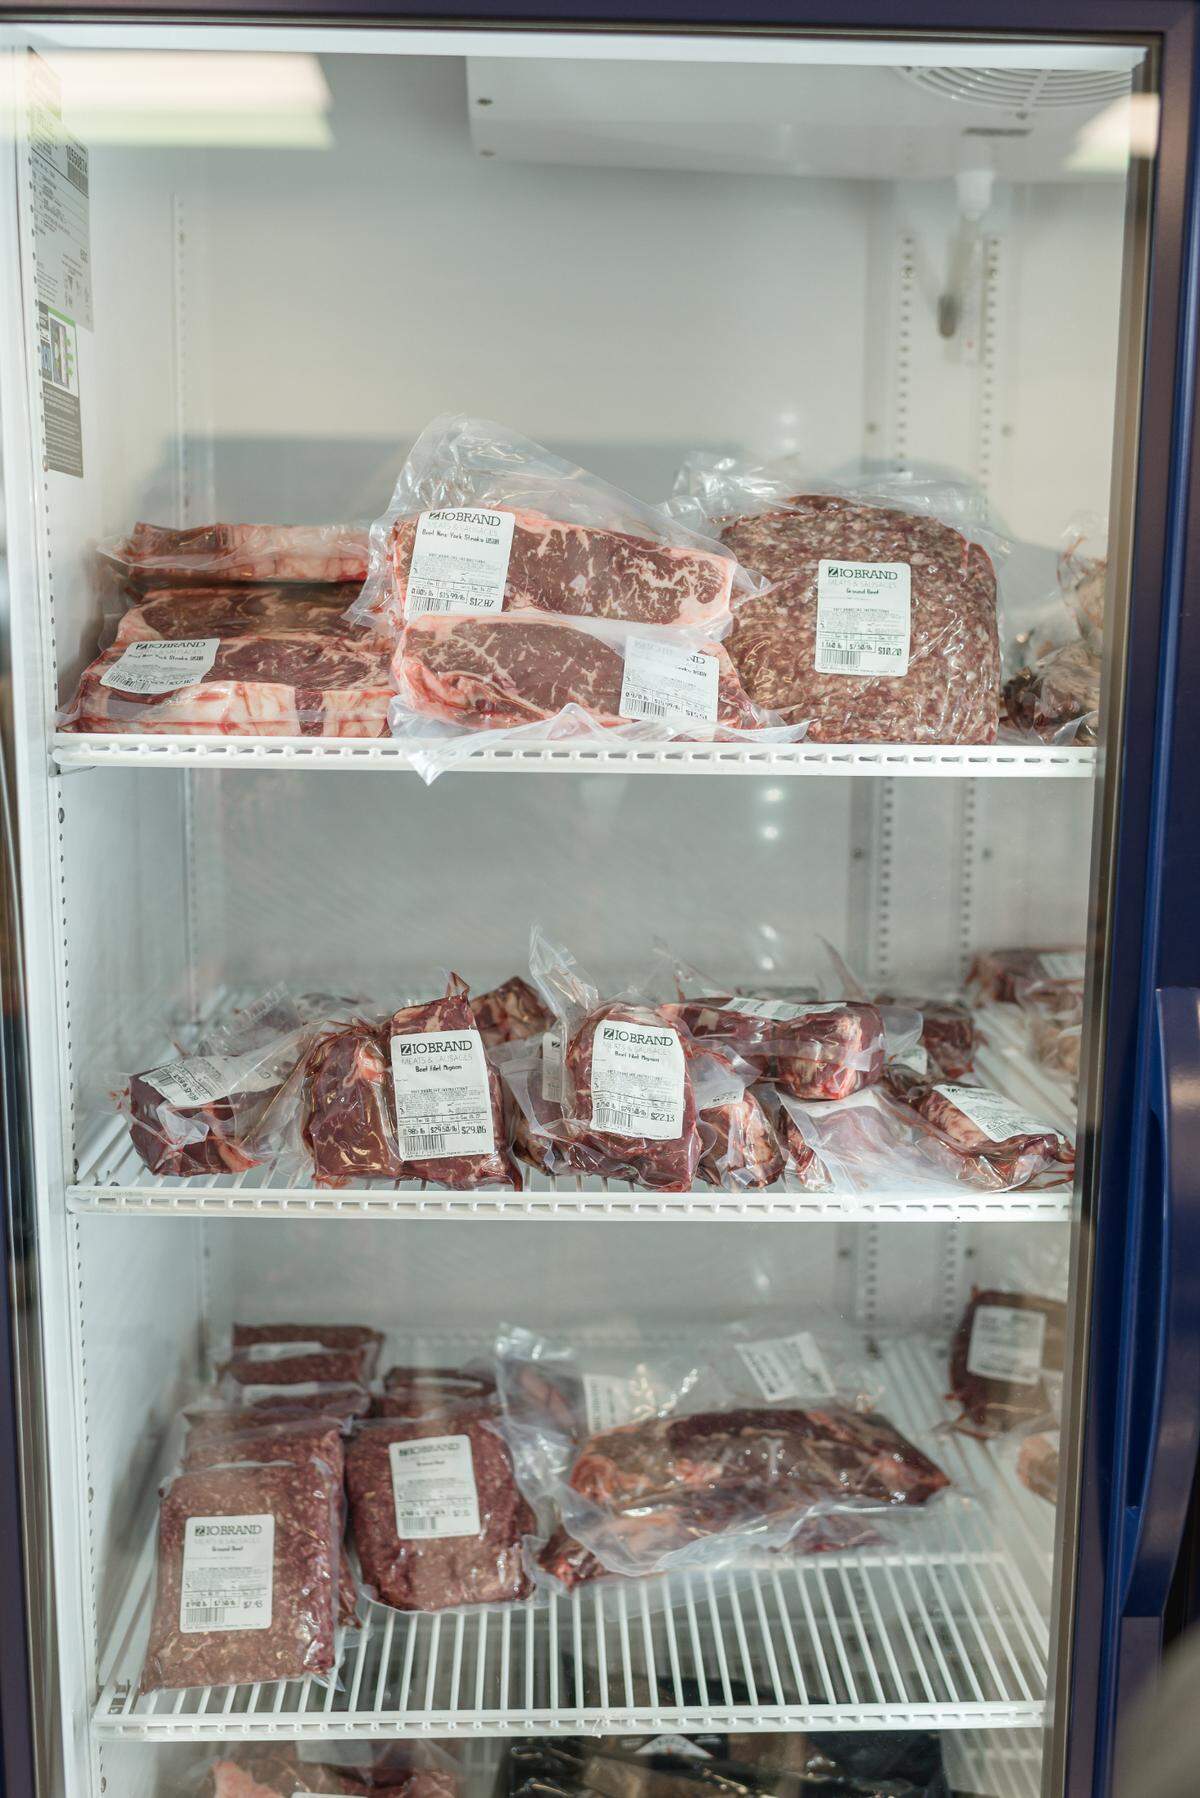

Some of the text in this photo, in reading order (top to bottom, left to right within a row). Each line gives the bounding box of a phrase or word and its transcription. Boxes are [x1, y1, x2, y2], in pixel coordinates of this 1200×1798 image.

[450, 532, 462, 540] York
[828, 566, 898, 580] ZIOBRAND
[603, 1027, 674, 1047] ZIOBRAND
[400, 1040, 473, 1056] ZIOBRAND
[650, 1112, 675, 1122] $22.13
[461, 1125, 487, 1135] $29.06
[194, 1525, 262, 1537] ZIOBRAND
